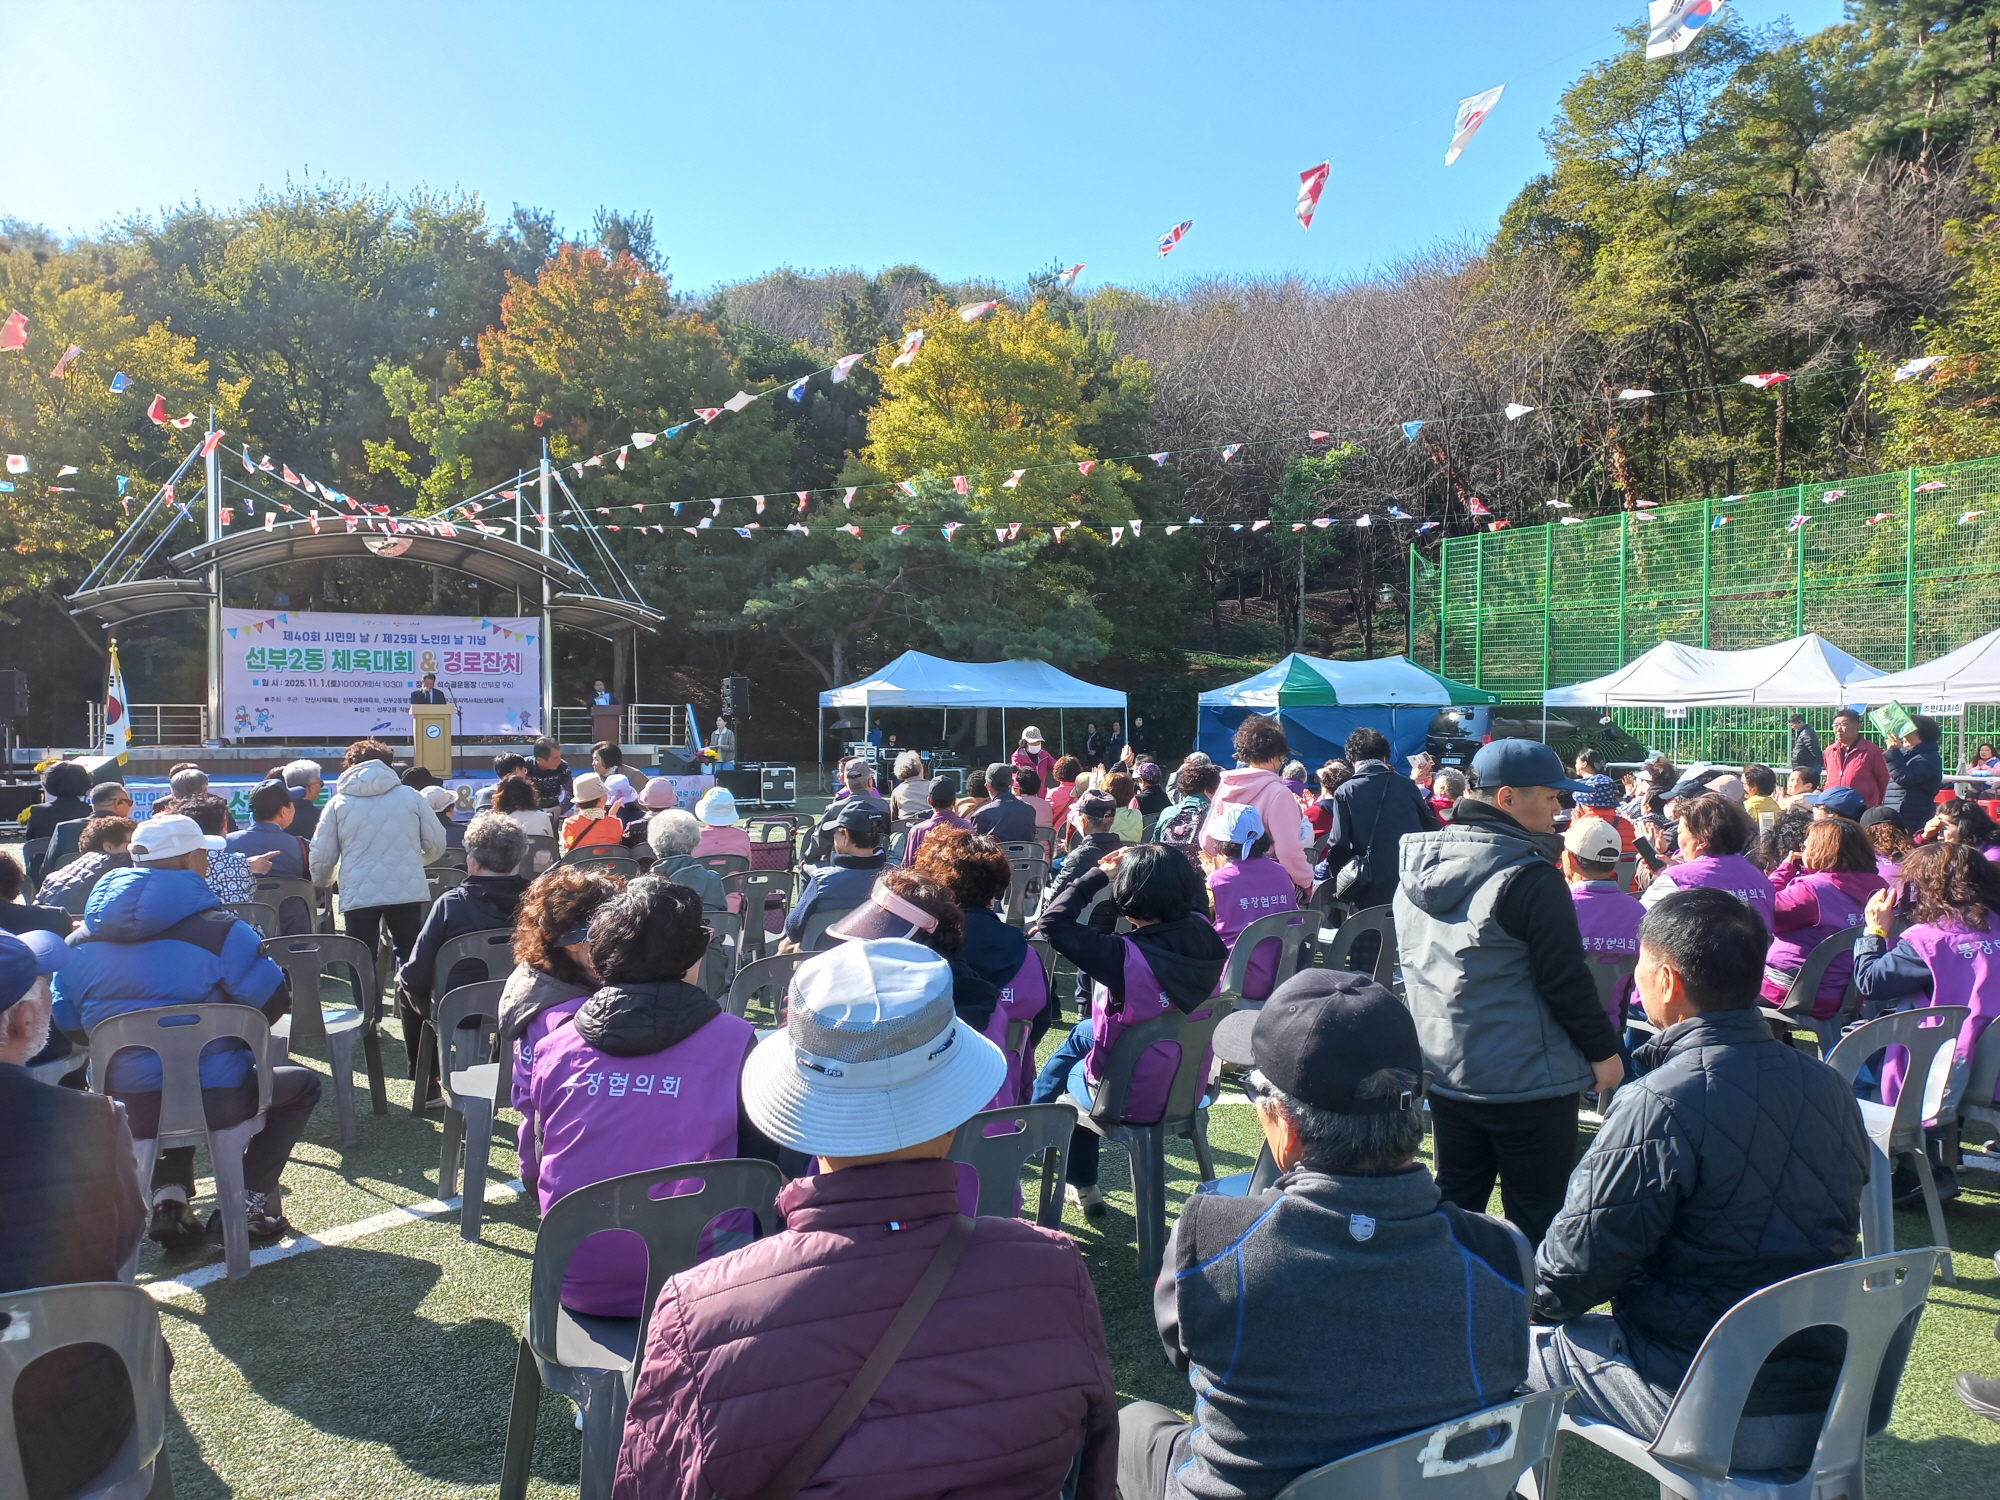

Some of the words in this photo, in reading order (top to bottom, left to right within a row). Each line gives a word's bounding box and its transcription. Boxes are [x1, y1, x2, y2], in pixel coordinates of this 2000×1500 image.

[283, 630, 320, 642] 제40회
[324, 631, 356, 643] 시민의
[359, 632, 370, 643] 날
[382, 633, 417, 645] 제29회
[421, 634, 450, 645] 노인의
[454, 634, 464, 645] 날
[467, 635, 487, 646] 기념
[245, 646, 324, 671] 선부2동
[331, 648, 413, 672] 체육대회
[420, 650, 437, 672] &
[443, 651, 520, 673] 경로잔치
[284, 679, 307, 688] 2025.
[437, 680, 477, 689] 석수골운동장
[502, 681, 514, 689] 96)
[1923, 703, 1963, 714] 주민자치회
[1239, 894, 1288, 910] 통장협의회
[567, 1071, 682, 1098] 장협의회
